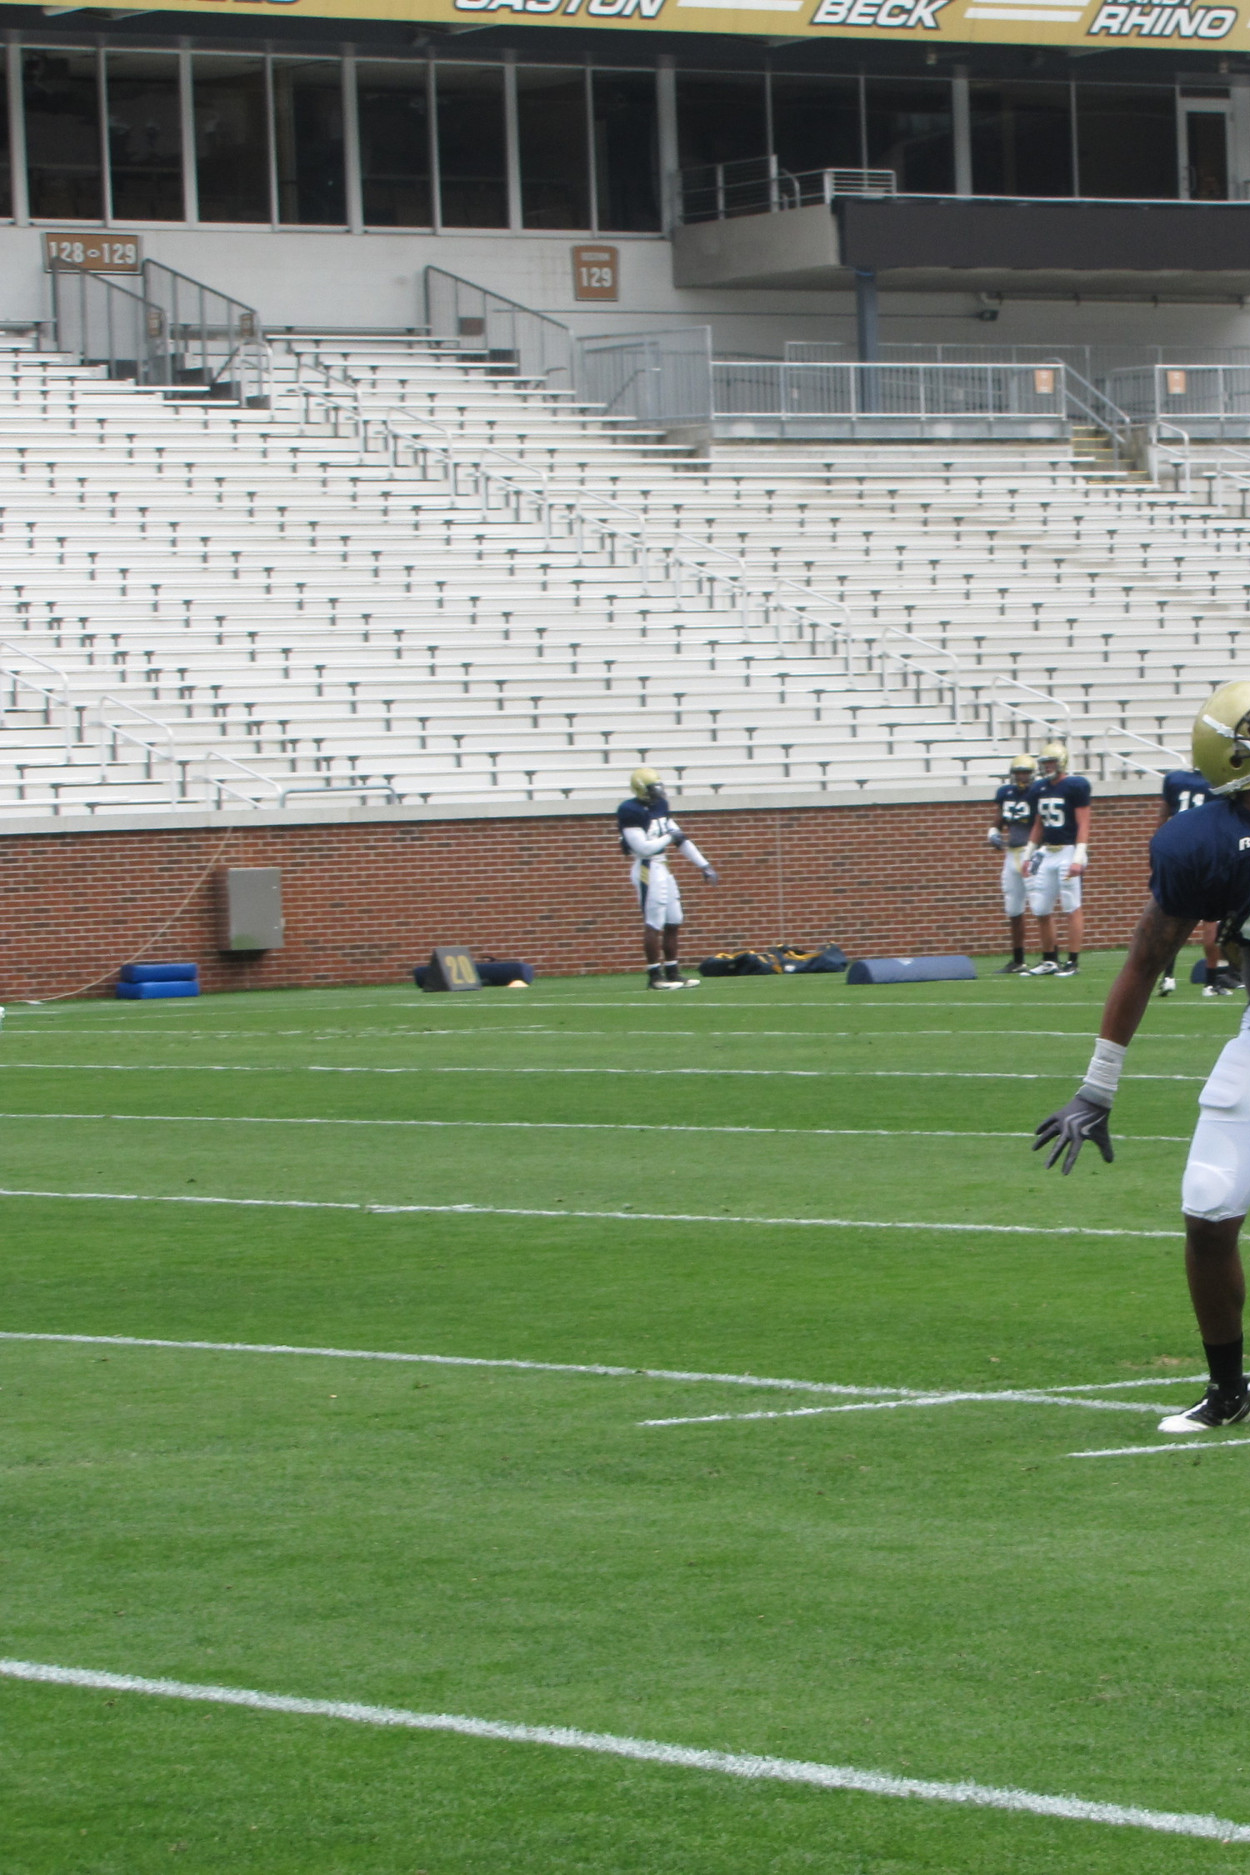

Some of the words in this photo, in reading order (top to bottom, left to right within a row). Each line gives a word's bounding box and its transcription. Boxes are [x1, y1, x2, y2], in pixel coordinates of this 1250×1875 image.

[811, 0, 948, 29] BECK
[1088, 6, 1238, 39] RHINO
[49, 241, 85, 263] 128
[102, 243, 137, 265] 129
[580, 267, 613, 287] 129
[1037, 797, 1066, 827] 55
[444, 954, 477, 984] 20
